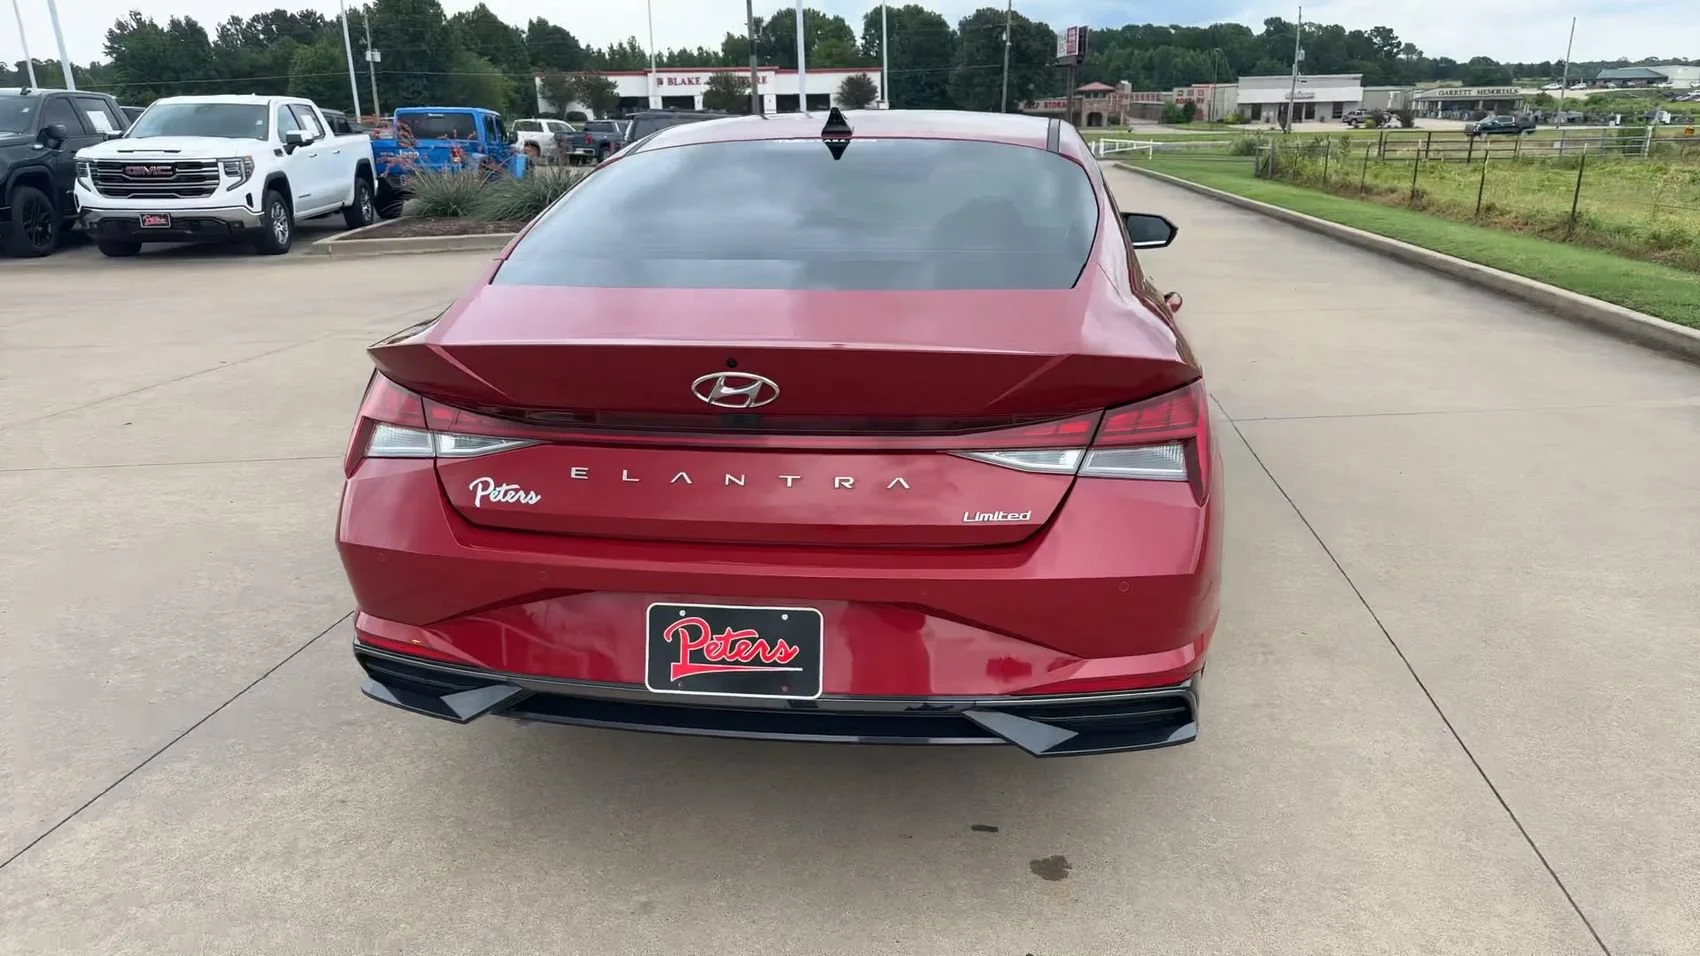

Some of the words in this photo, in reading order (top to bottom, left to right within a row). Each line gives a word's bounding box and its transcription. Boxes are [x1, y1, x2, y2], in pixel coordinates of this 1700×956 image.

[667, 77, 700, 86] BLAKE
[1438, 88, 1472, 96] GARRETT
[1477, 87, 1519, 95] MEMORIALS
[125, 165, 172, 176] GMC
[570, 466, 911, 489] ELANTRA
[469, 476, 542, 507] Peters
[962, 510, 1032, 523] Limited
[663, 616, 803, 681] Peters
